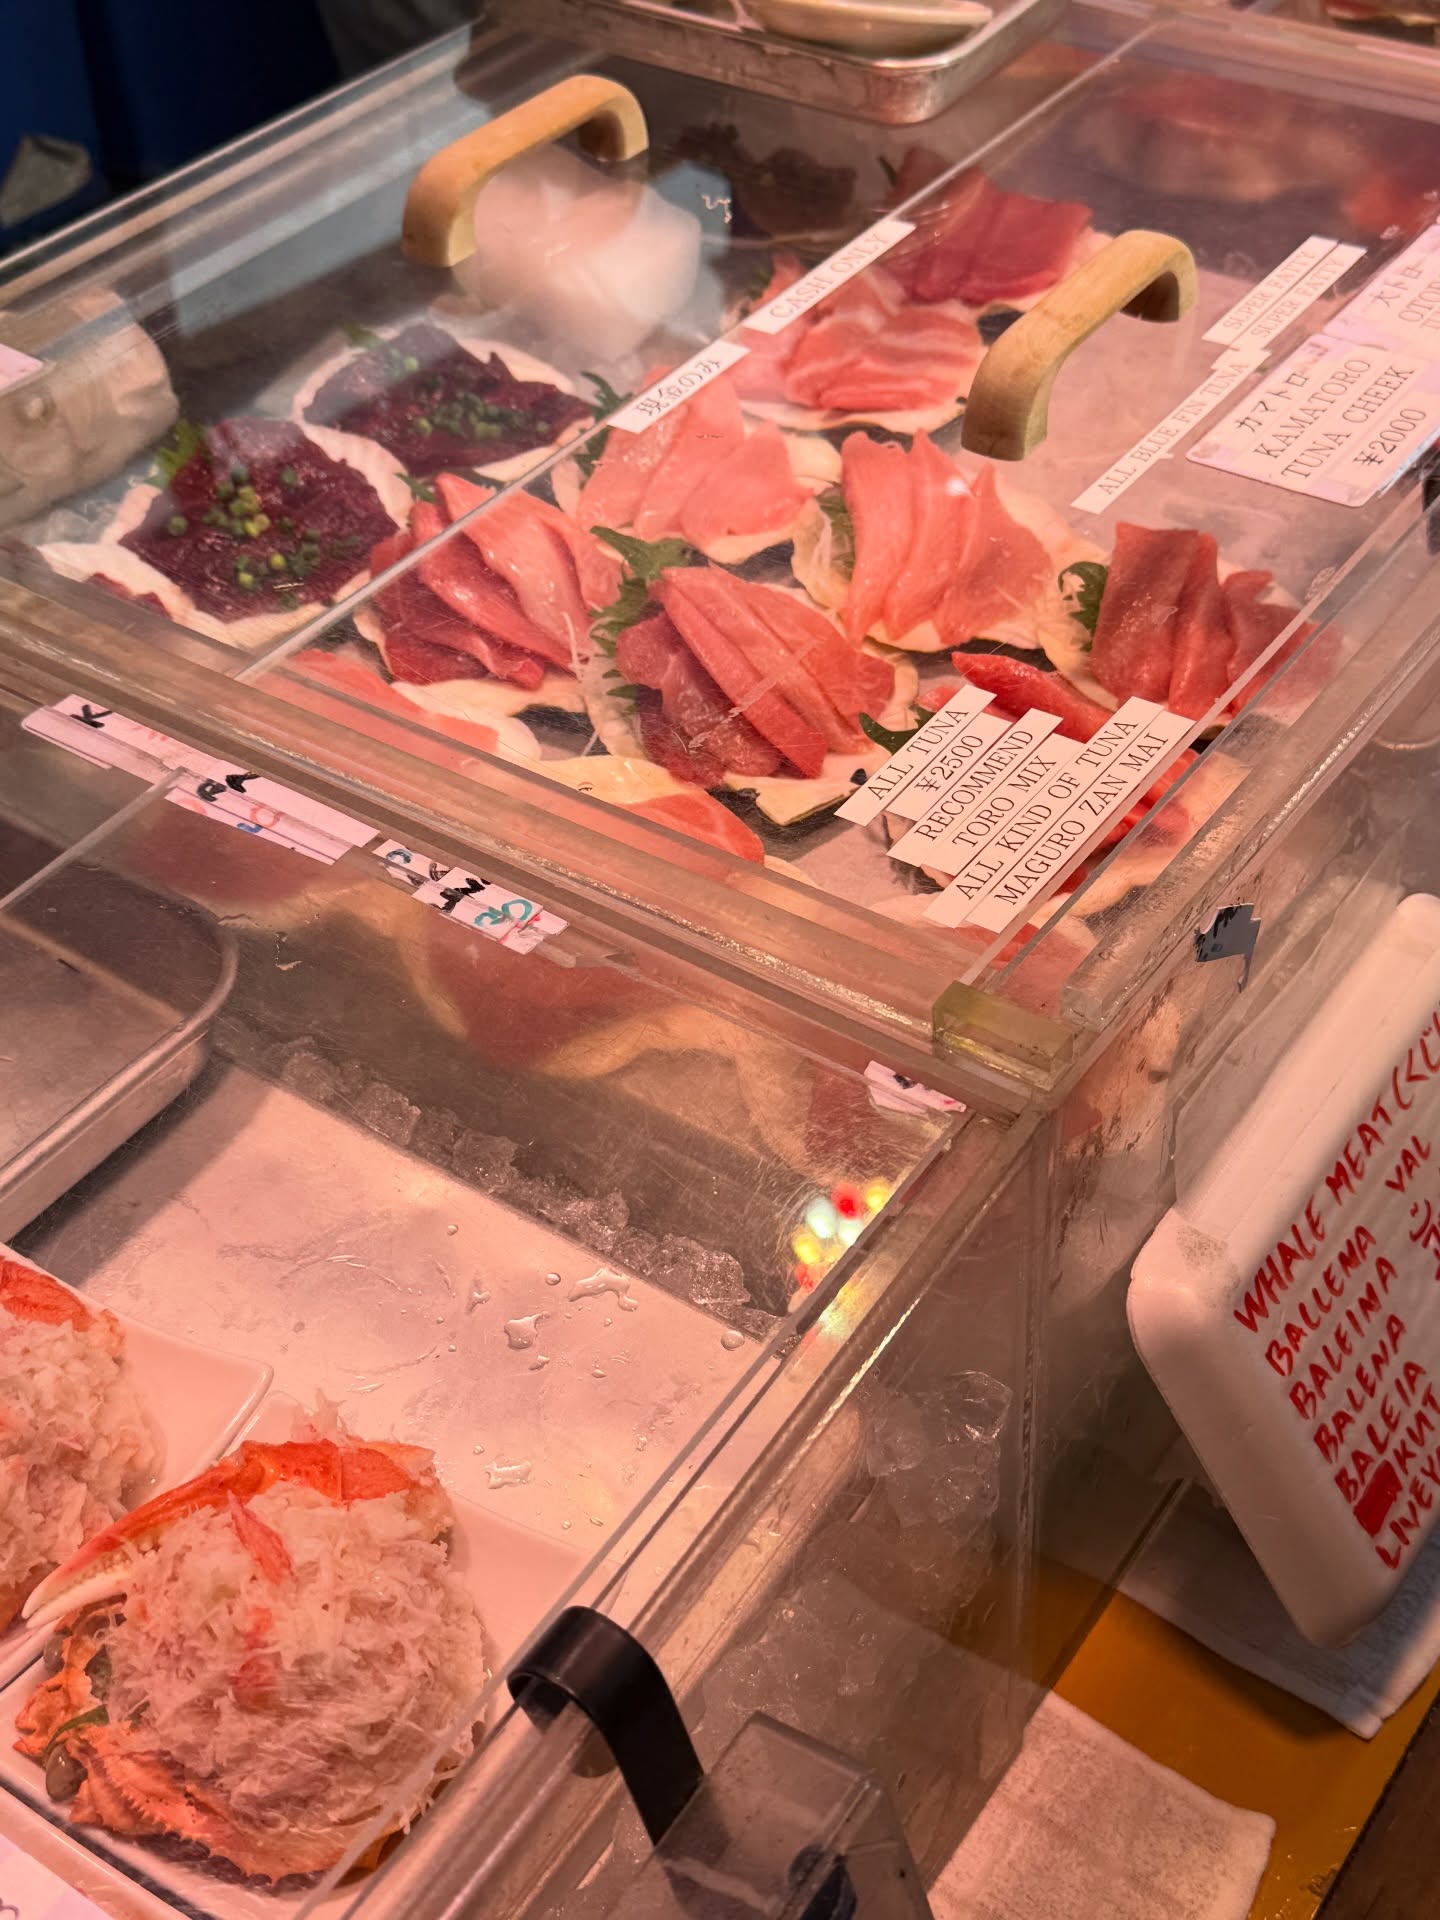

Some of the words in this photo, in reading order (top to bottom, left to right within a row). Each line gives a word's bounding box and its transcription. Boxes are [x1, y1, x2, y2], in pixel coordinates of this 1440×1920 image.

[769, 273, 834, 321] CASH
[830, 234, 889, 274] ONLY
[1222, 291, 1269, 330] SUPER
[1267, 250, 1315, 292] FATTY
[1251, 299, 1298, 338] SUPER
[1296, 257, 1345, 301] FATTY
[635, 358, 723, 416] 現金のみ
[1098, 463, 1136, 495] ALL
[1131, 425, 1180, 462] BLUE
[1172, 399, 1206, 425] FIN
[1202, 362, 1249, 400] TUNA
[1237, 371, 1309, 432] カマトロ
[1253, 359, 1370, 459] KAMATORO
[1281, 430, 1352, 479] TUNA
[1341, 365, 1415, 424] CHEEK
[1352, 407, 1427, 467] ¥2000
[867, 761, 914, 801] ALL
[906, 707, 970, 756] TUNA
[914, 734, 984, 793] ¥2500
[915, 729, 1034, 842] RECOMMEND
[952, 795, 1015, 849] TORO
[1007, 756, 1057, 796] MIX
[955, 861, 1003, 901] ALL
[998, 804, 1053, 854] KIND
[1048, 772, 1082, 800] OF
[1076, 719, 1139, 770] TUNA
[993, 818, 1086, 906] MAGURO
[1081, 774, 1128, 817] ZAN
[1119, 732, 1169, 773] MAI
[1233, 1194, 1325, 1333] WHALE
[1265, 1225, 1376, 1376] BALLENA
[1385, 1135, 1431, 1193] VAL
[1289, 1256, 1399, 1420] BALEINA
[1314, 1314, 1406, 1464] BALENA
[1334, 1361, 1426, 1504] BALEIA
